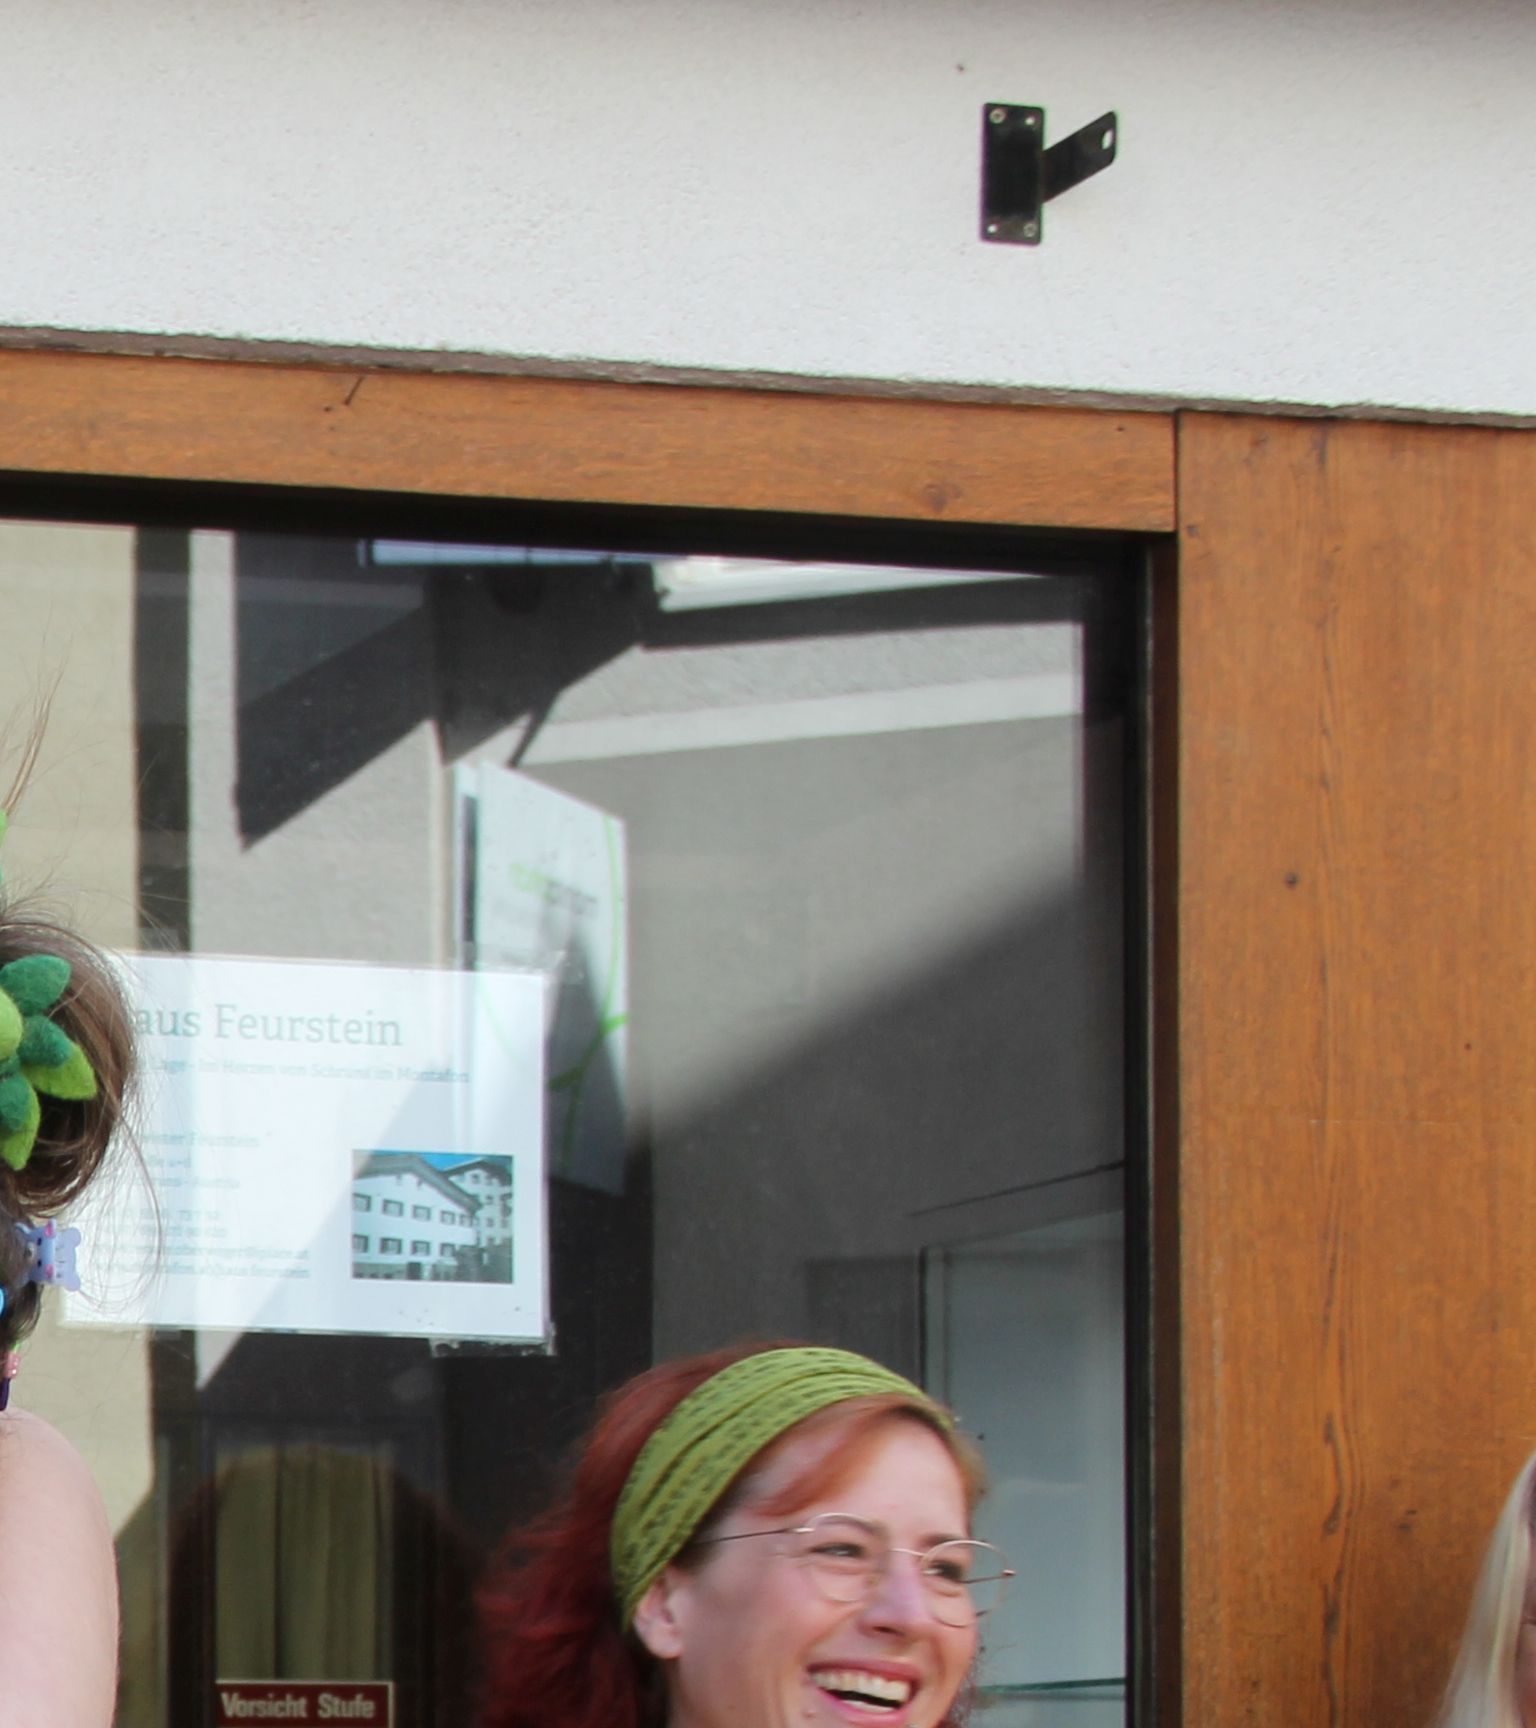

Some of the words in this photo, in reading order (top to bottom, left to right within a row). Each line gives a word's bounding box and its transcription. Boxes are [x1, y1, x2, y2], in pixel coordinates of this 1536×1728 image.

[134, 1008, 202, 1038] aus
[214, 1003, 403, 1046] Feurstein
[221, 1692, 308, 1719] Vorsicht
[317, 1692, 376, 1719] Stufe
